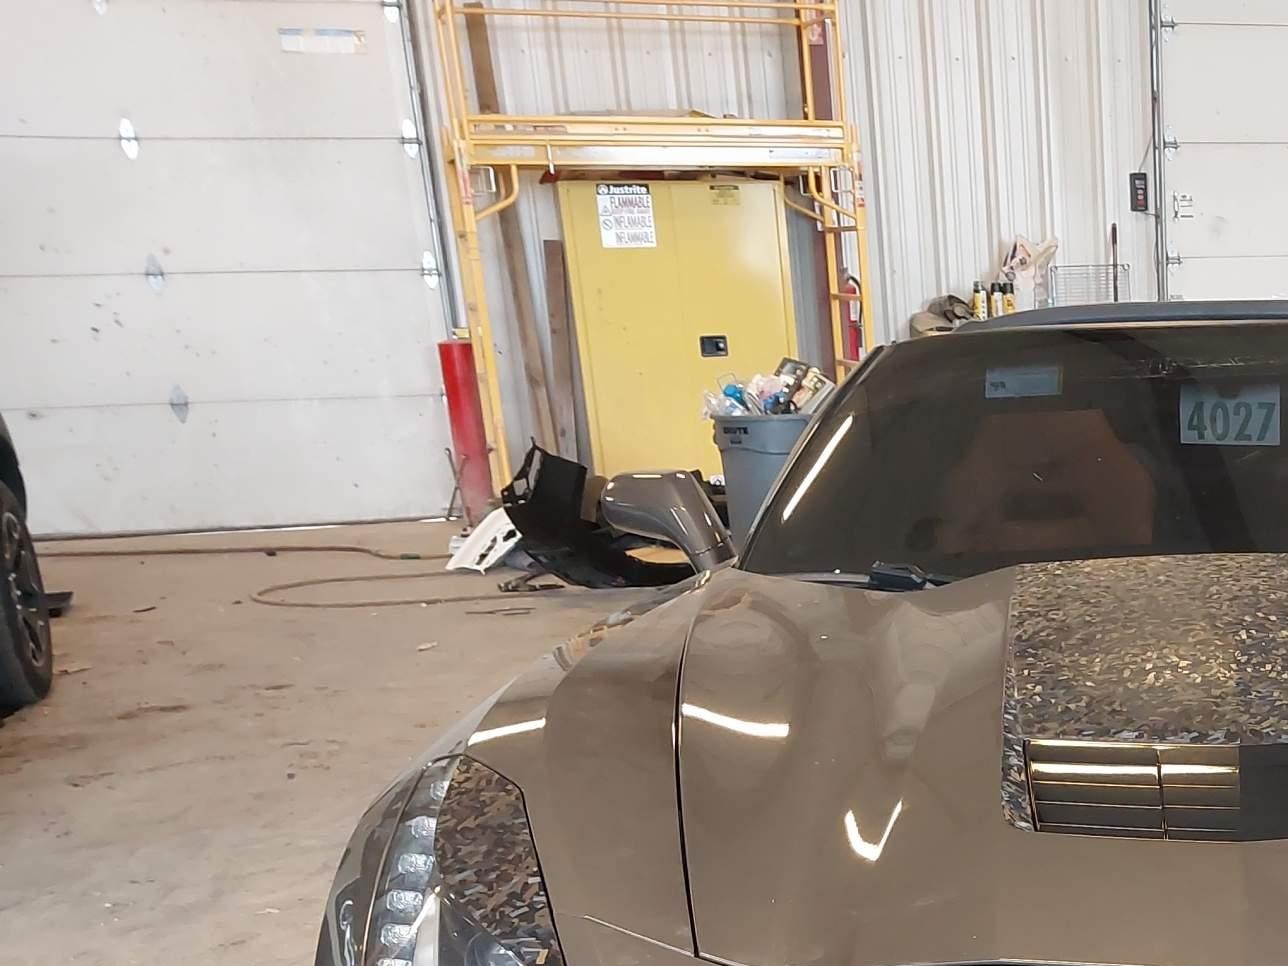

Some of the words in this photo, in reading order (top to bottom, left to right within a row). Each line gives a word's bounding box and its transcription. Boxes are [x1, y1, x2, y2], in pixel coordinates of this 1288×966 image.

[609, 184, 648, 194] Justrite
[610, 196, 650, 208] FLAMMABLE
[1187, 400, 1276, 441] 4027
